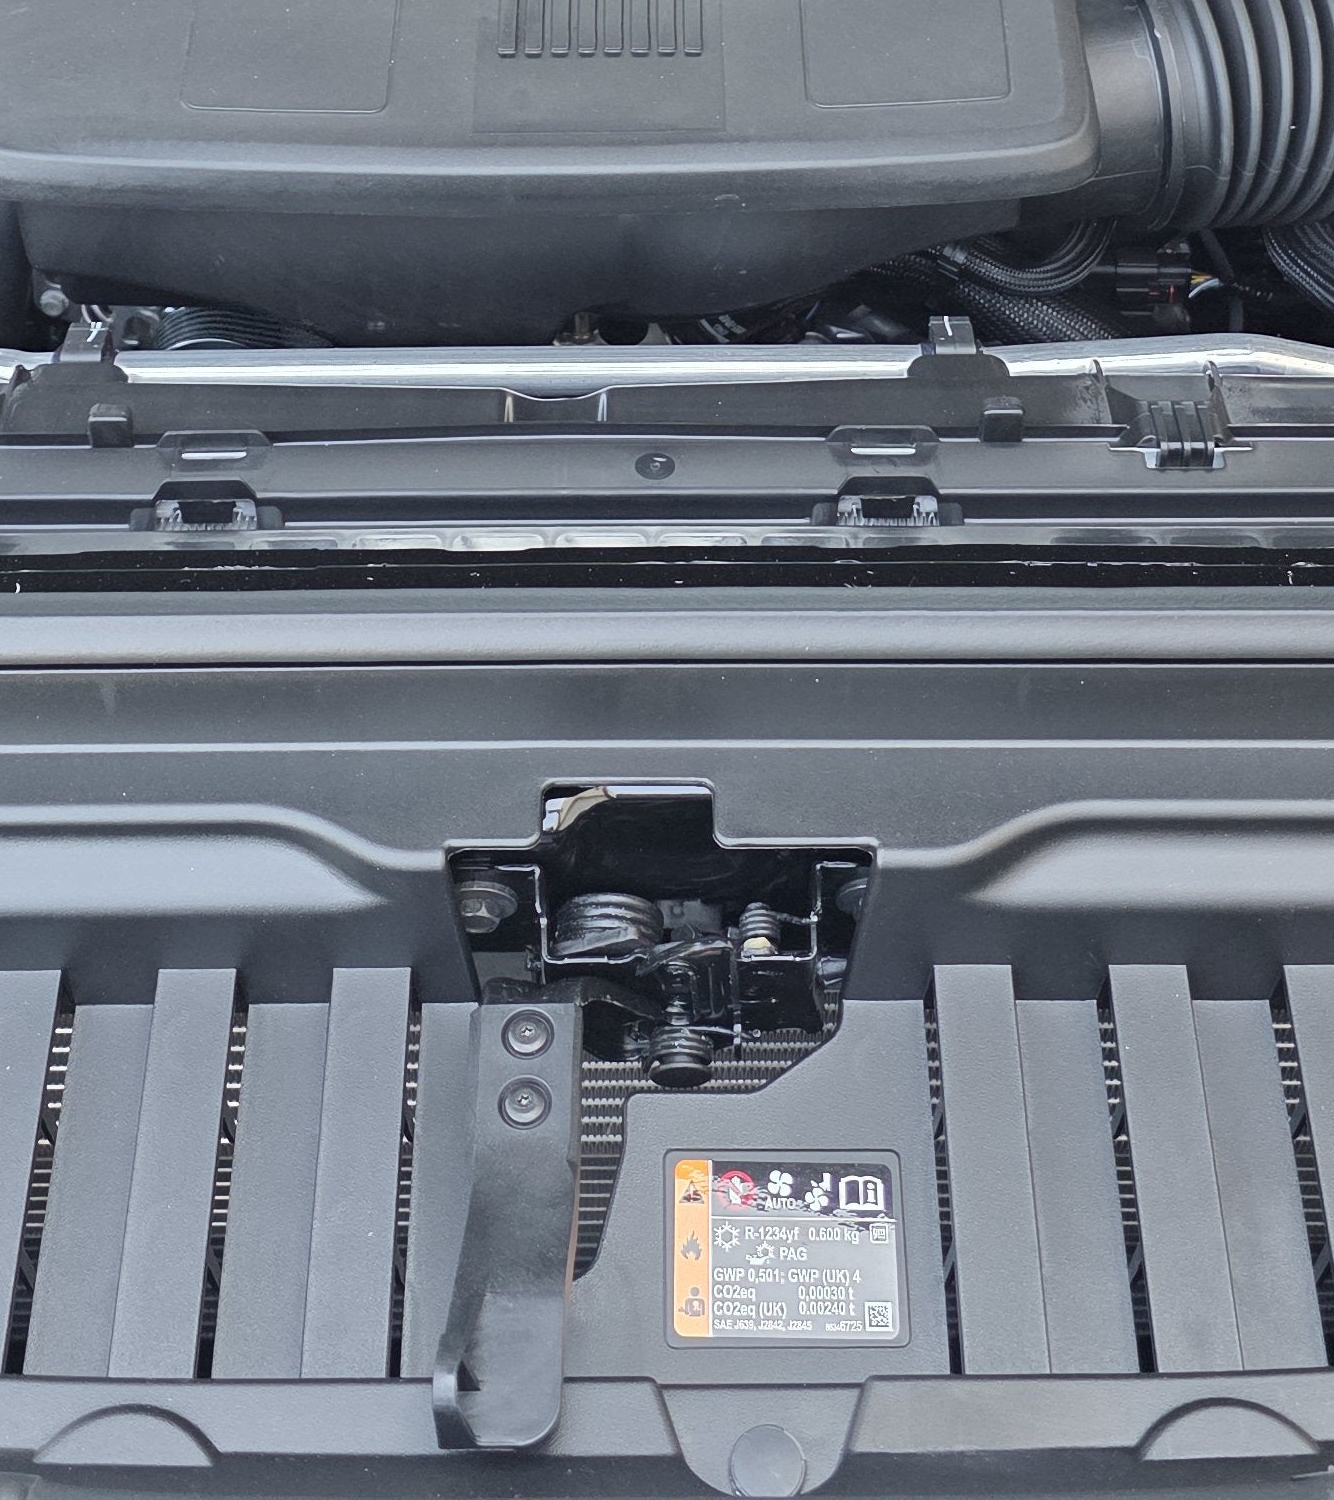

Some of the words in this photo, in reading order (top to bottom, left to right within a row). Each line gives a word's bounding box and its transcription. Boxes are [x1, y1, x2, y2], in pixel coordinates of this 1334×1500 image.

[764, 1197, 797, 1210] AUTO
[745, 1226, 799, 1243] R-1234yf
[808, 1227, 841, 1241] 0.600
[844, 1227, 860, 1244] kg
[779, 1247, 808, 1261] PAG
[713, 1267, 745, 1282] GWP
[747, 1268, 786, 1284] 0,501;
[788, 1268, 819, 1283] GWP
[822, 1269, 850, 1286] (UK)
[852, 1269, 862, 1284] 4
[713, 1284, 756, 1302] CO2eq
[848, 1286, 856, 1301] t
[713, 1301, 756, 1319] CO2eq
[759, 1301, 787, 1320] (UK)
[798, 1301, 846, 1316] 0.00240
[848, 1301, 857, 1316] t
[713, 1319, 733, 1330] SAE
